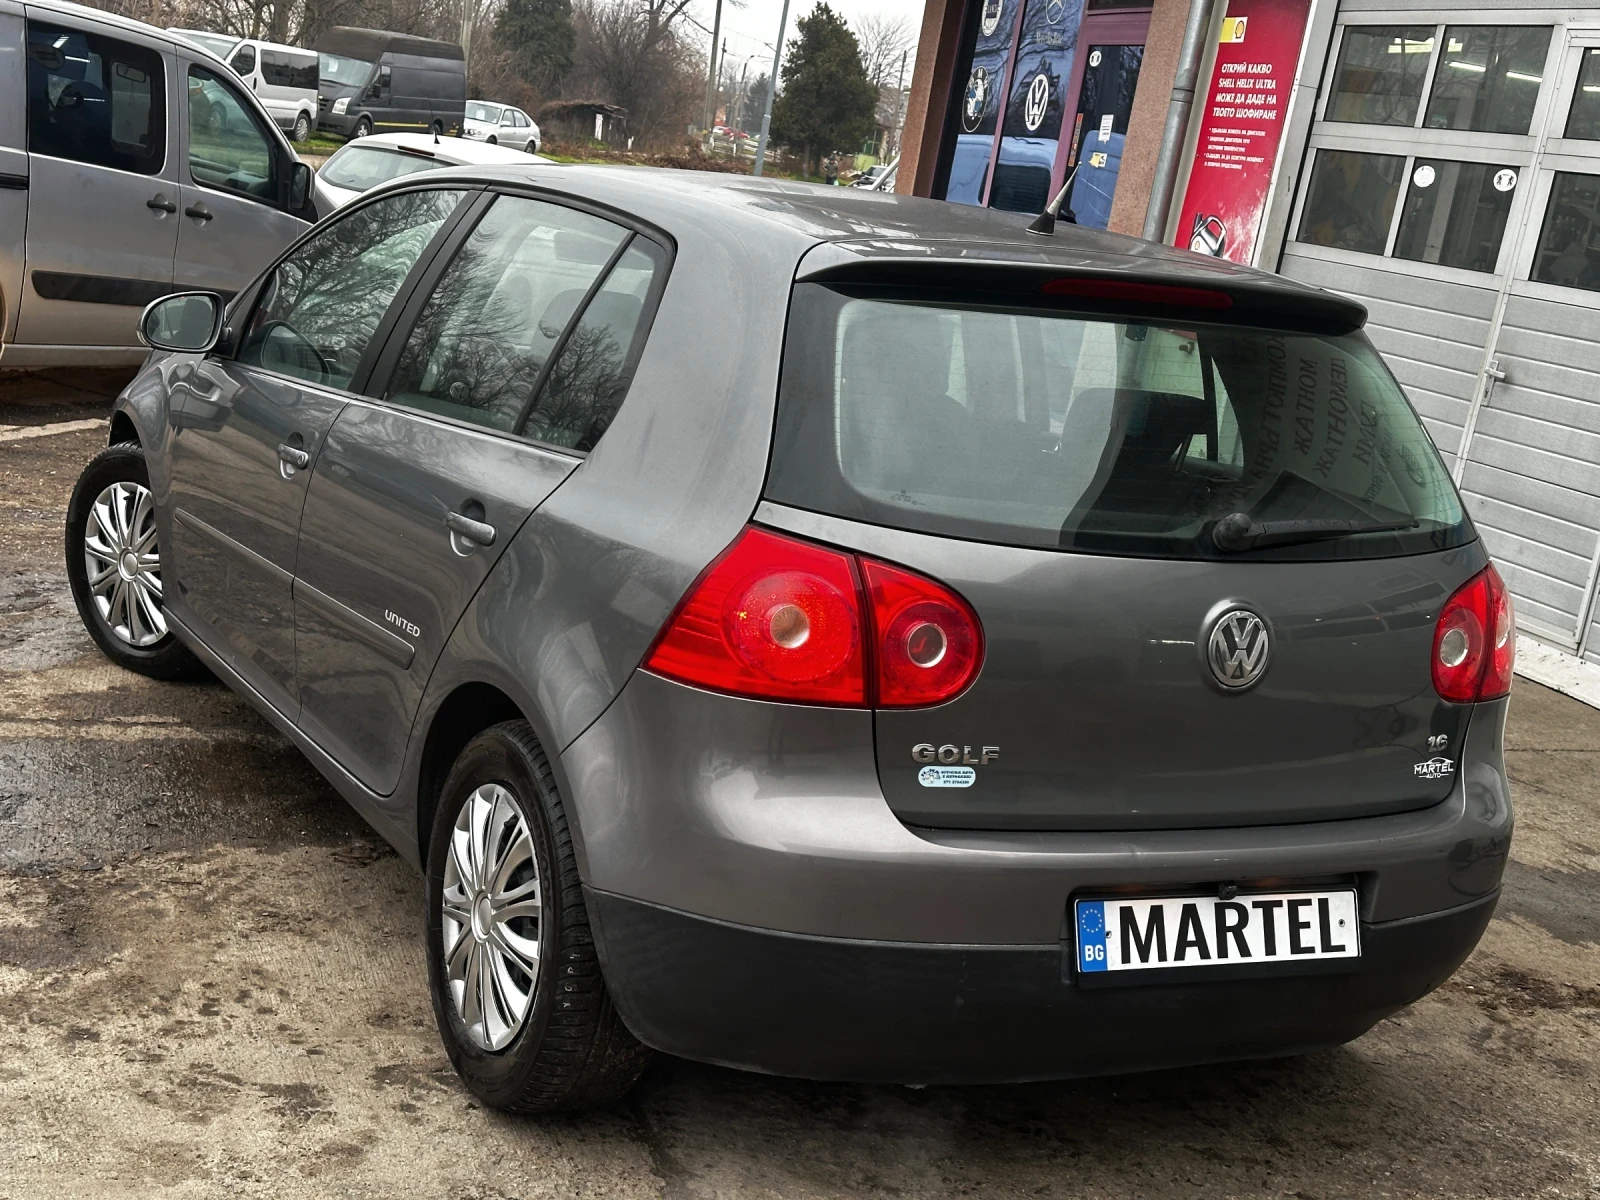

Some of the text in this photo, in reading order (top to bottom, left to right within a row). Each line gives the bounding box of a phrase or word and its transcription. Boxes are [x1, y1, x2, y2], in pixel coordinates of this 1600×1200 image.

[1222, 62, 1272, 74] ОТКРИЙ КАКВО
[1218, 78, 1276, 89] SHELL HELIX ULTRA
[1215, 92, 1277, 105] МОЖЕ ДА ДАДЕ НА
[1212, 107, 1277, 120] ТВОЕТО ШОФИРАНЕ
[384, 609, 421, 637] UNITED
[911, 743, 1000, 765] GOLF
[1413, 762, 1454, 775] MARTEL
[1084, 897, 1346, 965] BG MARTEL
